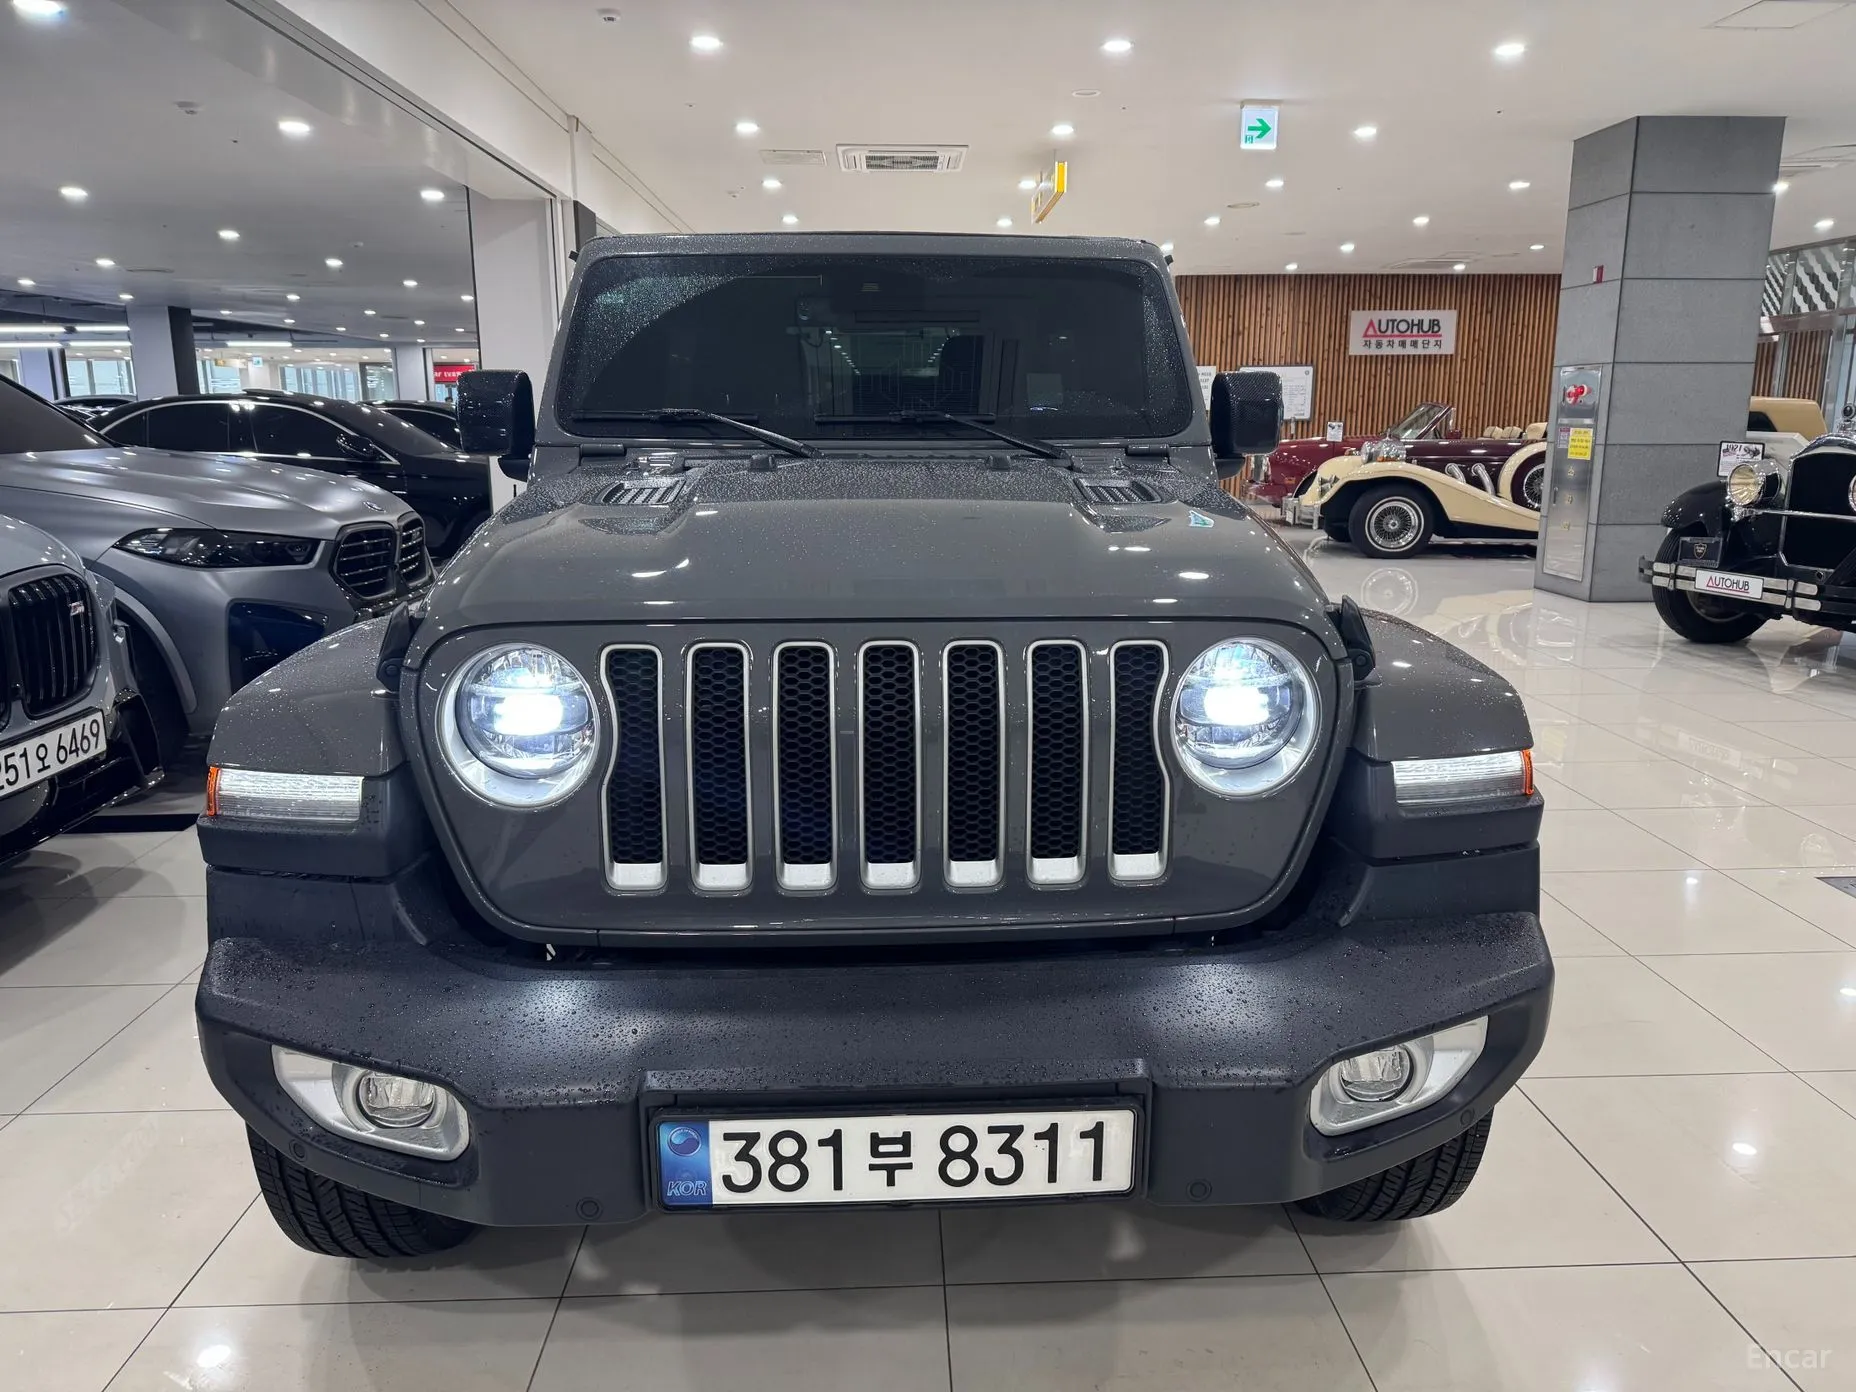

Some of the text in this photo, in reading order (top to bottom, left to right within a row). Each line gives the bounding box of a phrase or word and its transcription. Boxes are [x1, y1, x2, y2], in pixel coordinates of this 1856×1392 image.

[1363, 318, 1442, 338] AUTOHUB
[1706, 575, 1750, 593] AUTOHUB
[56, 719, 100, 765] 6469
[938, 1121, 1105, 1188] 8311
[667, 1181, 707, 1196] KOR
